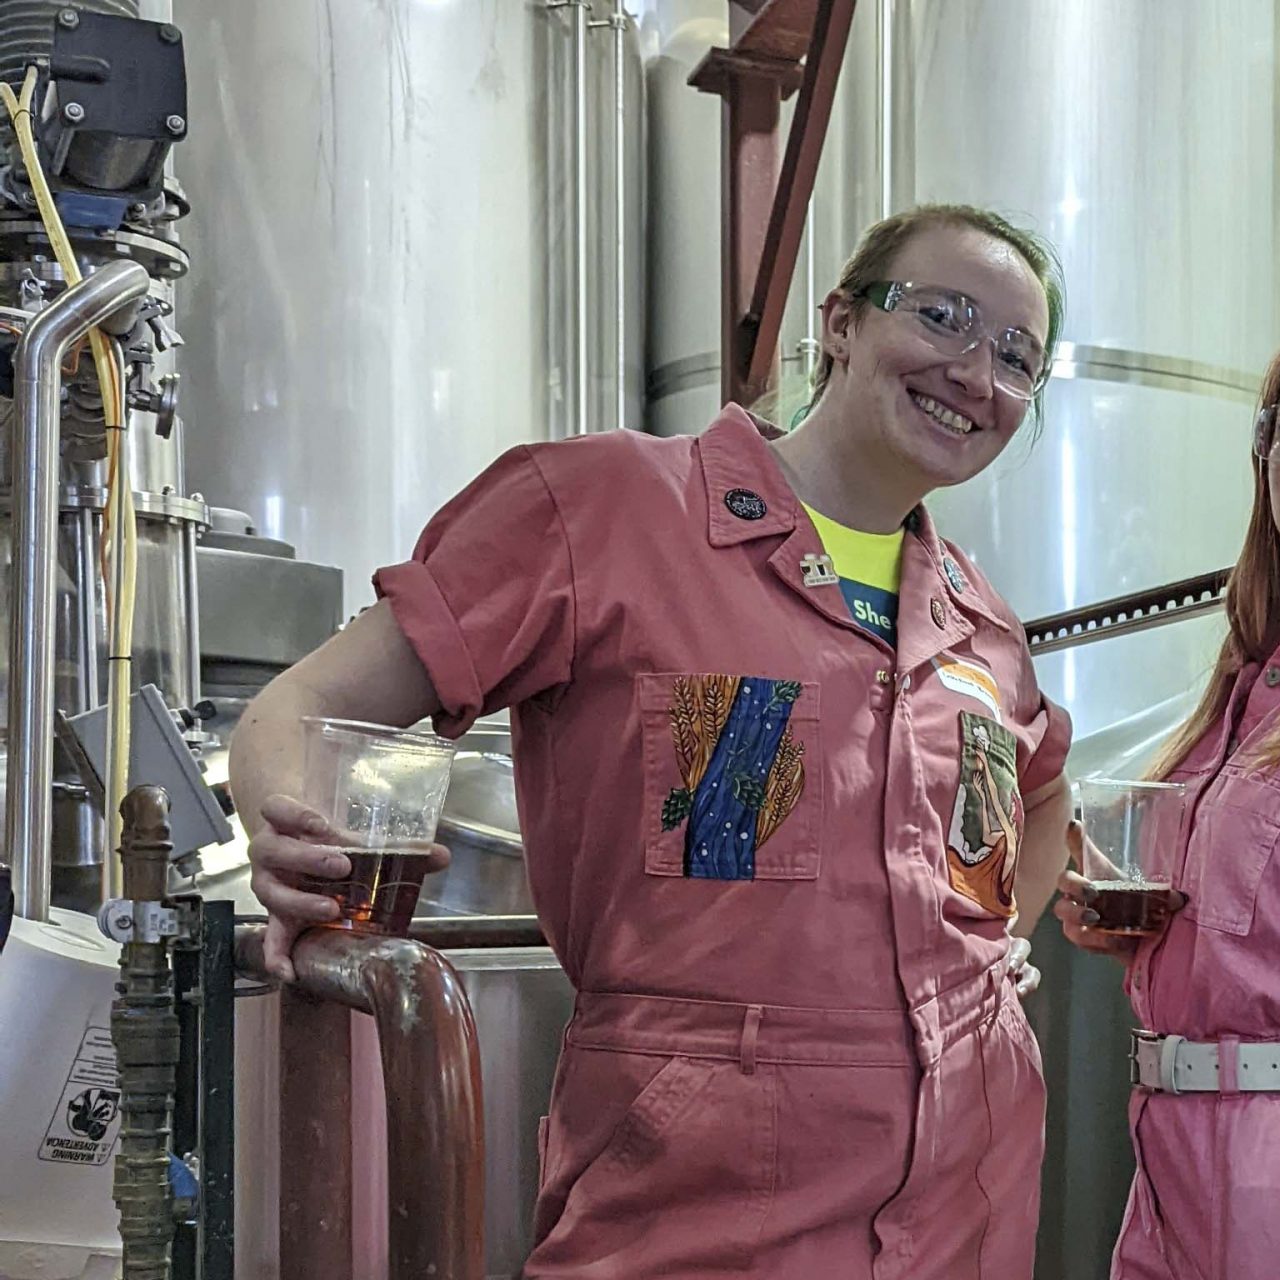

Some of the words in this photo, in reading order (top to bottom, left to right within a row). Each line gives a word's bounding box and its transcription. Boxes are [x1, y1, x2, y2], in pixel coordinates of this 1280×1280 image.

[852, 598, 892, 629] She
[46, 1137, 100, 1152] ADVERTENCIA
[51, 1148, 96, 1162] WARNING
